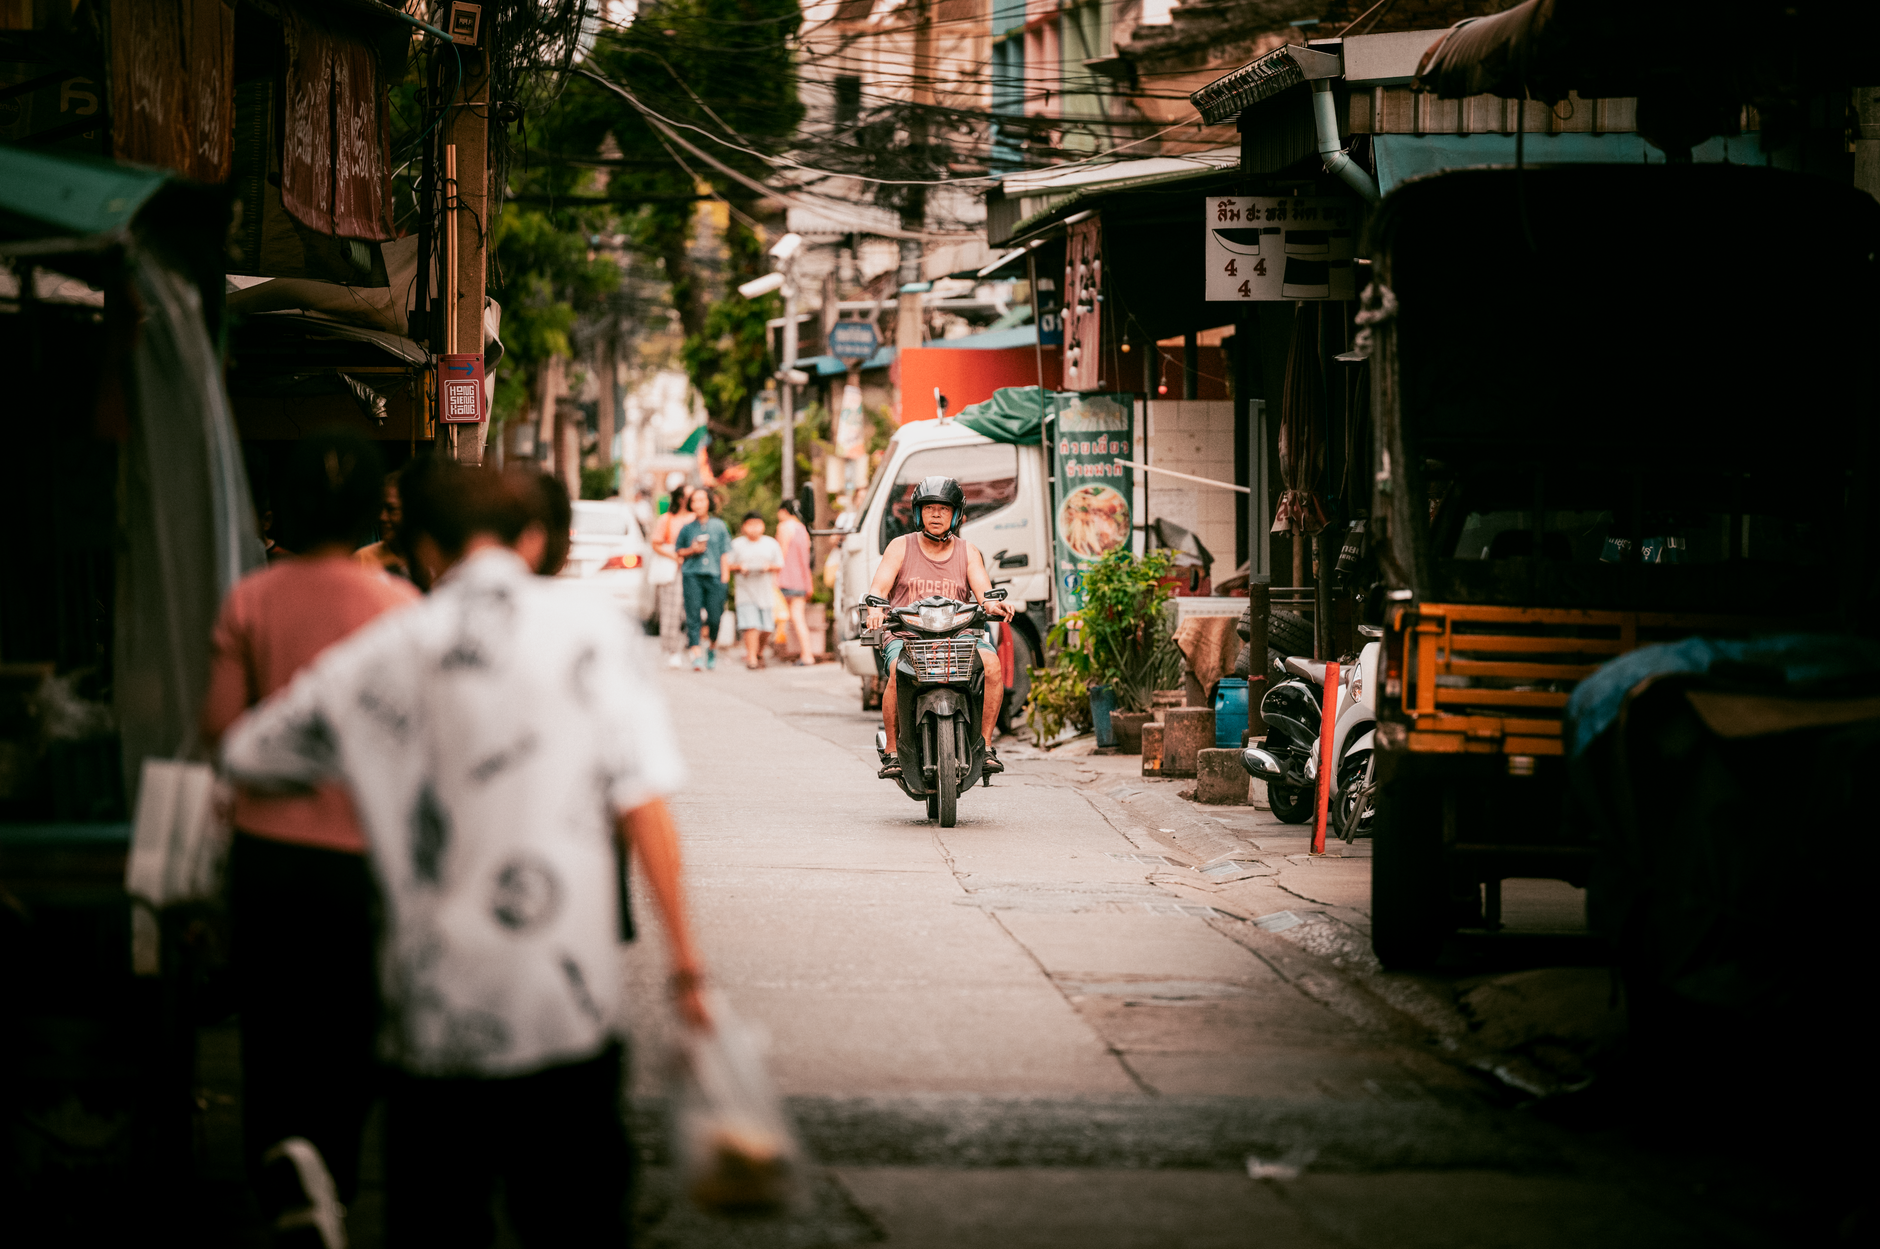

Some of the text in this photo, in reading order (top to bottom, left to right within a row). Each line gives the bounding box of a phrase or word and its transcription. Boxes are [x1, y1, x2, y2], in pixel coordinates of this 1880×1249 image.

[1224, 258, 1267, 277] 4 4
[1238, 279, 1251, 297] 4
[449, 385, 475, 396] HONG
[450, 396, 475, 405] SIENG
